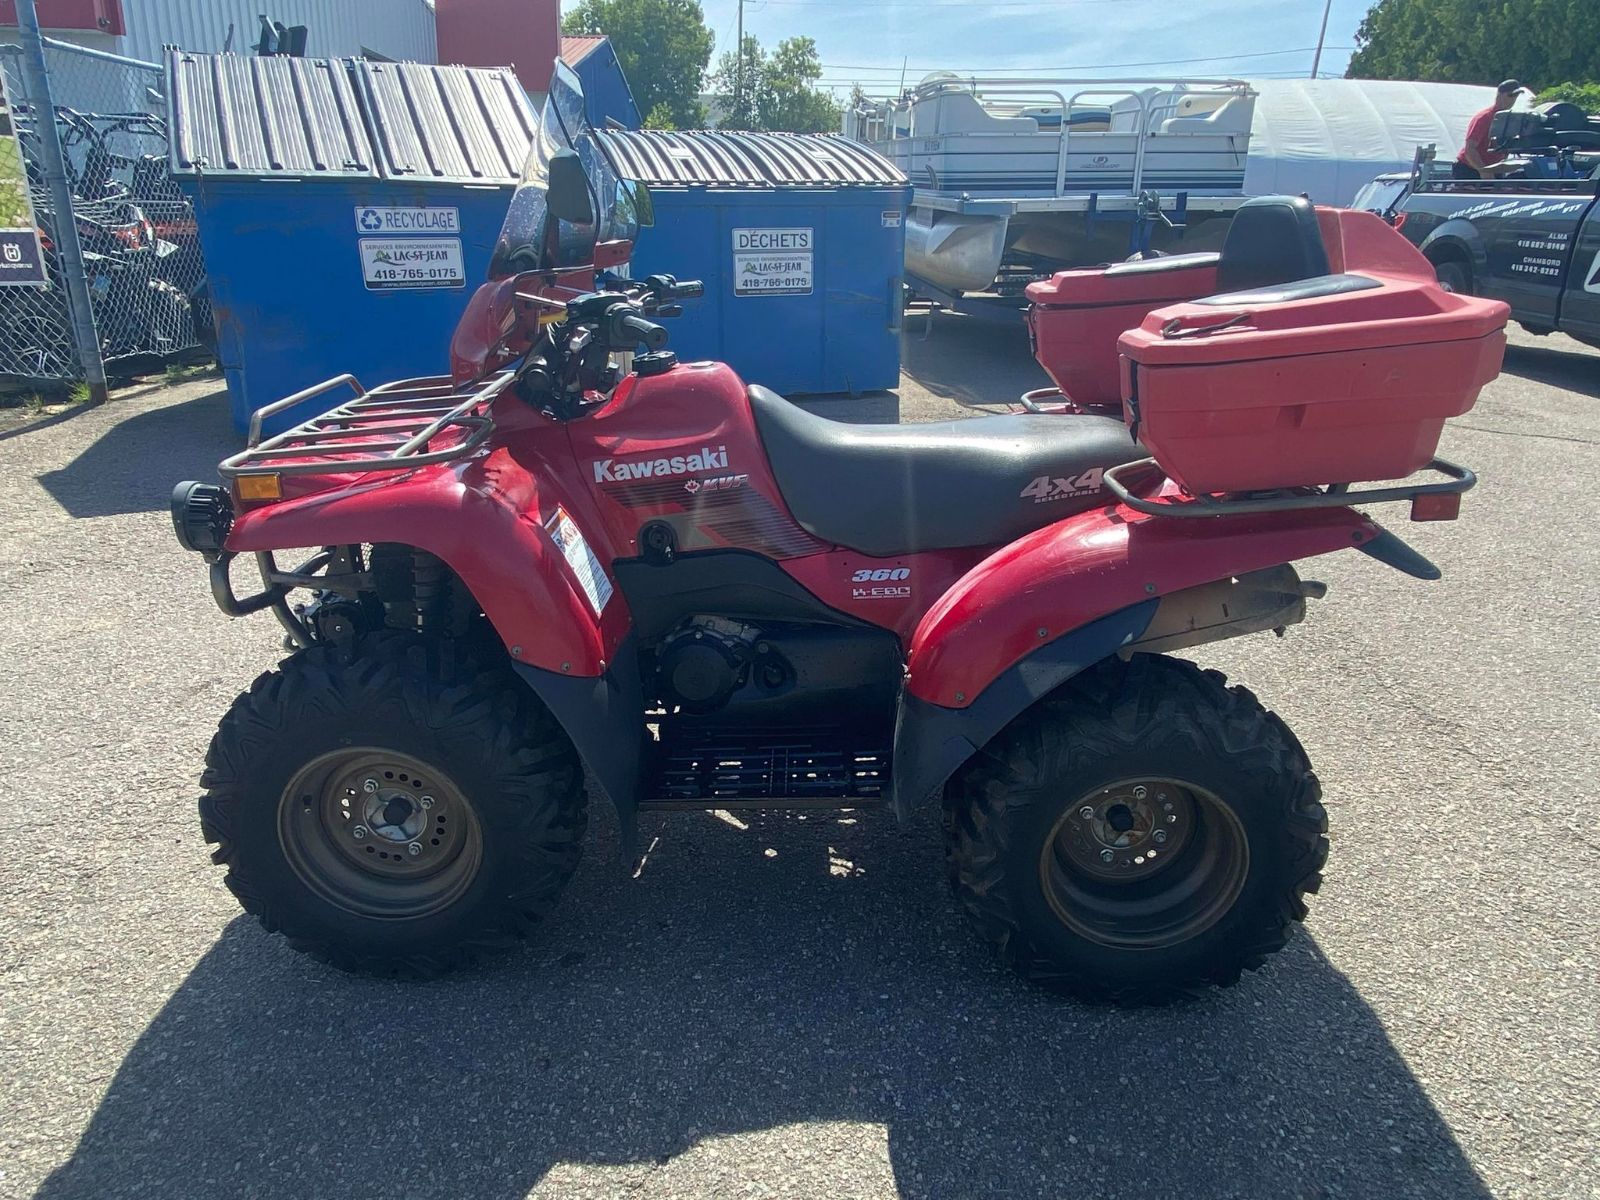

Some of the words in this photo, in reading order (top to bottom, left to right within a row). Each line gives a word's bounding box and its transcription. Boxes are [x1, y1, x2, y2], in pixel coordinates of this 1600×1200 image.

[385, 212, 455, 229] RECYCLAGE
[739, 230, 808, 248] DÉCHETS
[1523, 256, 1561, 267] CHAMBORD
[374, 268, 457, 279] 418-765-0175
[742, 278, 807, 288] 418-765-0175
[593, 445, 729, 483] Kawasaki
[1020, 467, 1104, 498] 4x4
[1034, 488, 1101, 504] SELECTABLE
[852, 568, 911, 582] 360
[852, 586, 911, 596] K-EBC
